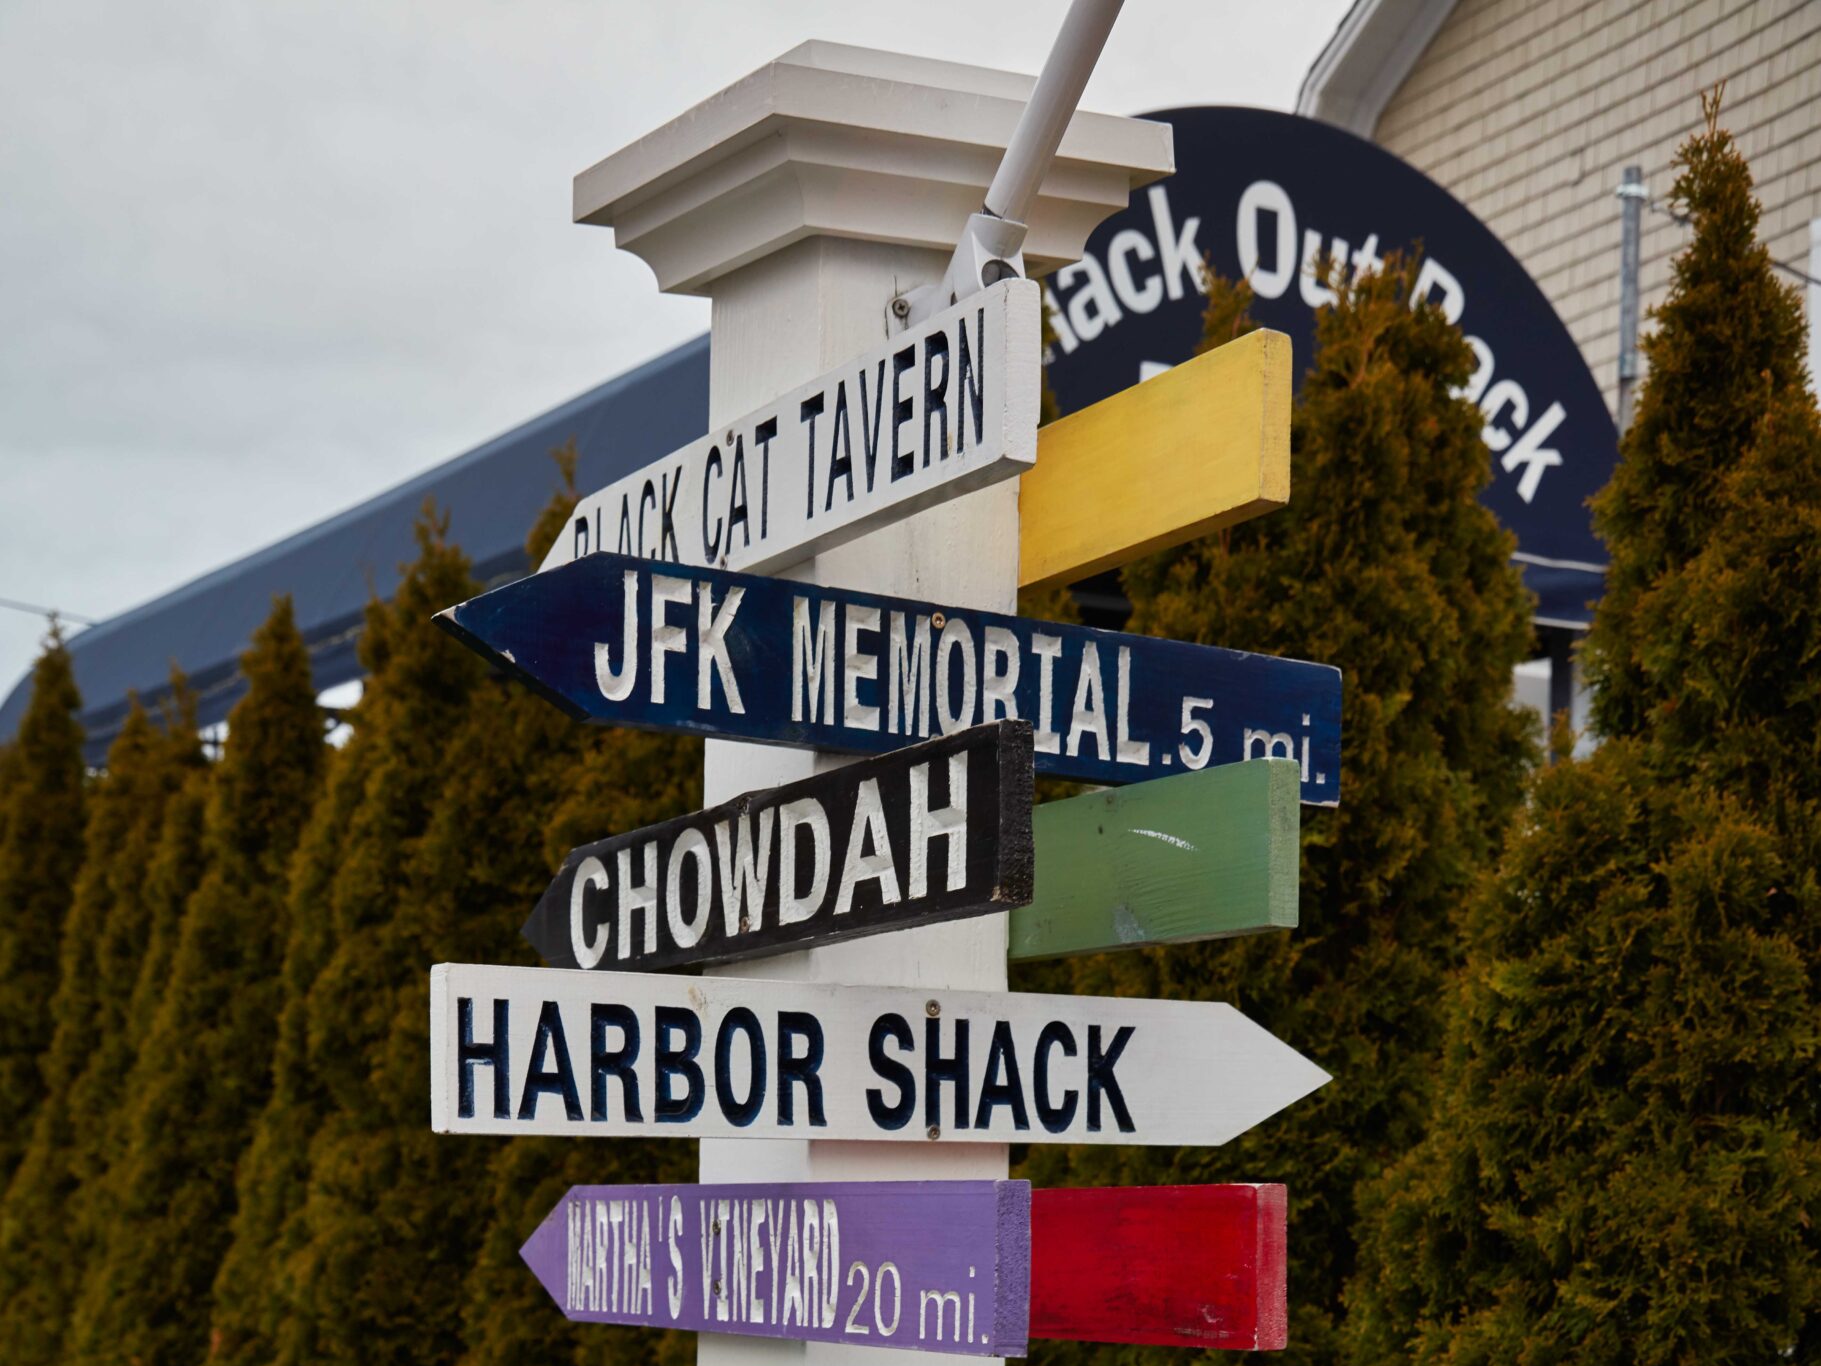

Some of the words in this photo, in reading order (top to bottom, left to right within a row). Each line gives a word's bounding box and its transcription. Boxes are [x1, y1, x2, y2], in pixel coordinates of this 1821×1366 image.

[703, 416, 778, 565] CAT
[800, 308, 984, 520] TAVERN
[594, 570, 746, 715] JFK
[792, 597, 1150, 767] MEMORIAL
[1243, 713, 1326, 785] mi.
[569, 749, 968, 969] CHOWDAH
[457, 998, 827, 1128] HARBOR
[866, 1013, 1137, 1133] SHACK
[567, 1195, 684, 1319] MARTHA'S
[699, 1198, 840, 1328] VINEYARD
[845, 1260, 901, 1336] 20
[919, 1265, 989, 1344] mi.
